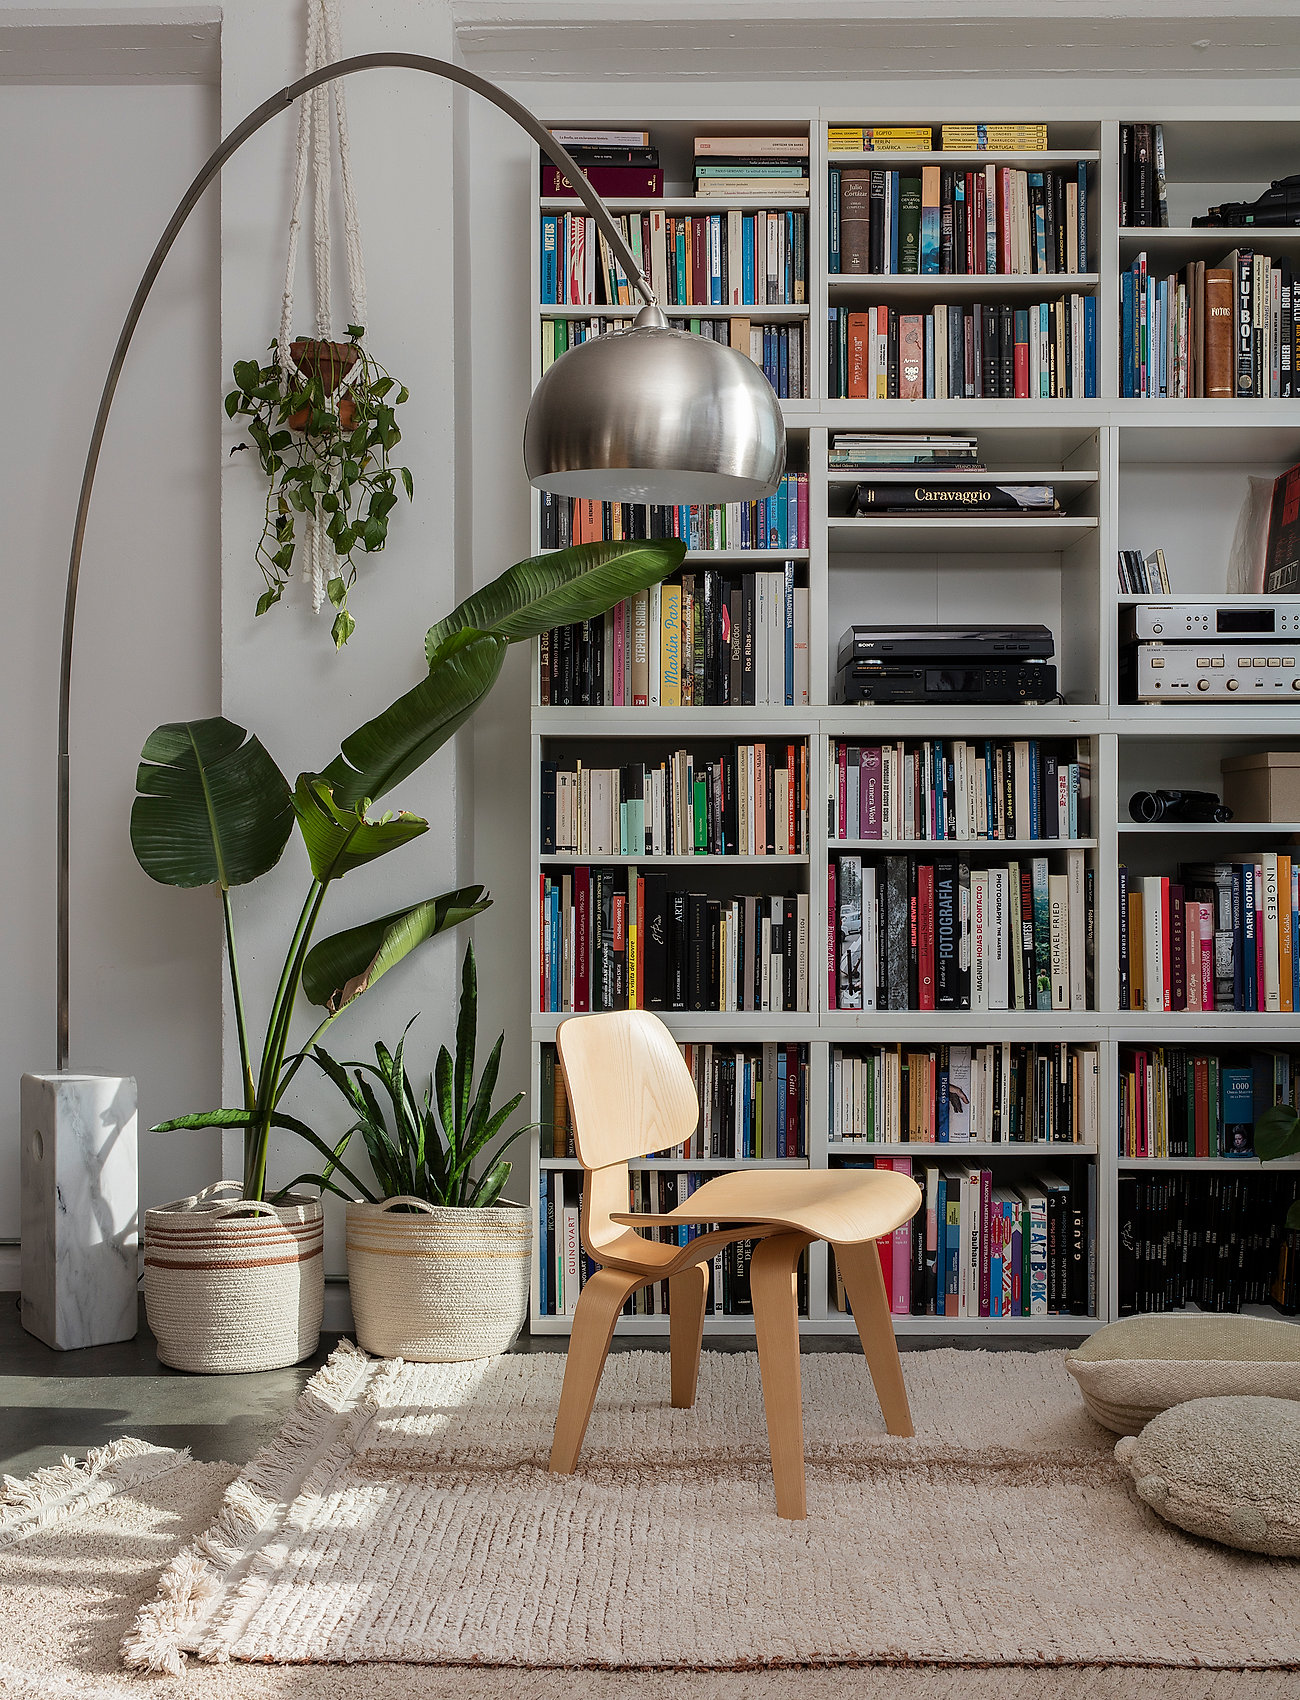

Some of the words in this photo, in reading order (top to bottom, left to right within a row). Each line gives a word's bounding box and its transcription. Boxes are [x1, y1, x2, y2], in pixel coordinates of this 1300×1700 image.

[943, 204, 952, 234] ESTRELLA
[545, 223, 554, 251] VICTUS
[1242, 266, 1251, 352] FUTBOL
[1282, 286, 1290, 308] BOOK
[1211, 307, 1230, 316] FOTOS
[1282, 309, 1290, 343] GRAFFITI
[1282, 345, 1291, 370] BOHER
[914, 488, 991, 504] Caravaggio
[636, 601, 645, 626] SHORE
[665, 594, 678, 629] Parr
[636, 628, 646, 663] STEPHEN
[732, 623, 741, 660] Depardon
[665, 634, 678, 684] Martin
[1022, 874, 1031, 892] KLEIN
[1267, 867, 1276, 920] INGRES
[675, 897, 683, 922] ARTE
[935, 879, 953, 958] FOTOGRAFÍA
[1022, 893, 1032, 920] WILLIAM
[977, 924, 982, 933] DE
[1023, 922, 1033, 950] MANIFEST
[1190, 973, 1198, 987] Capa
[1189, 988, 1197, 1004] Robert
[1031, 1202, 1046, 1229] THE
[568, 1216, 576, 1275] GUINOVART
[1030, 1233, 1047, 1259] ART
[1073, 1210, 1081, 1260] GAUDÍ
[745, 1249, 751, 1260] DE
[971, 1231, 979, 1268] bauhaus
[1031, 1262, 1047, 1302] BOOK
